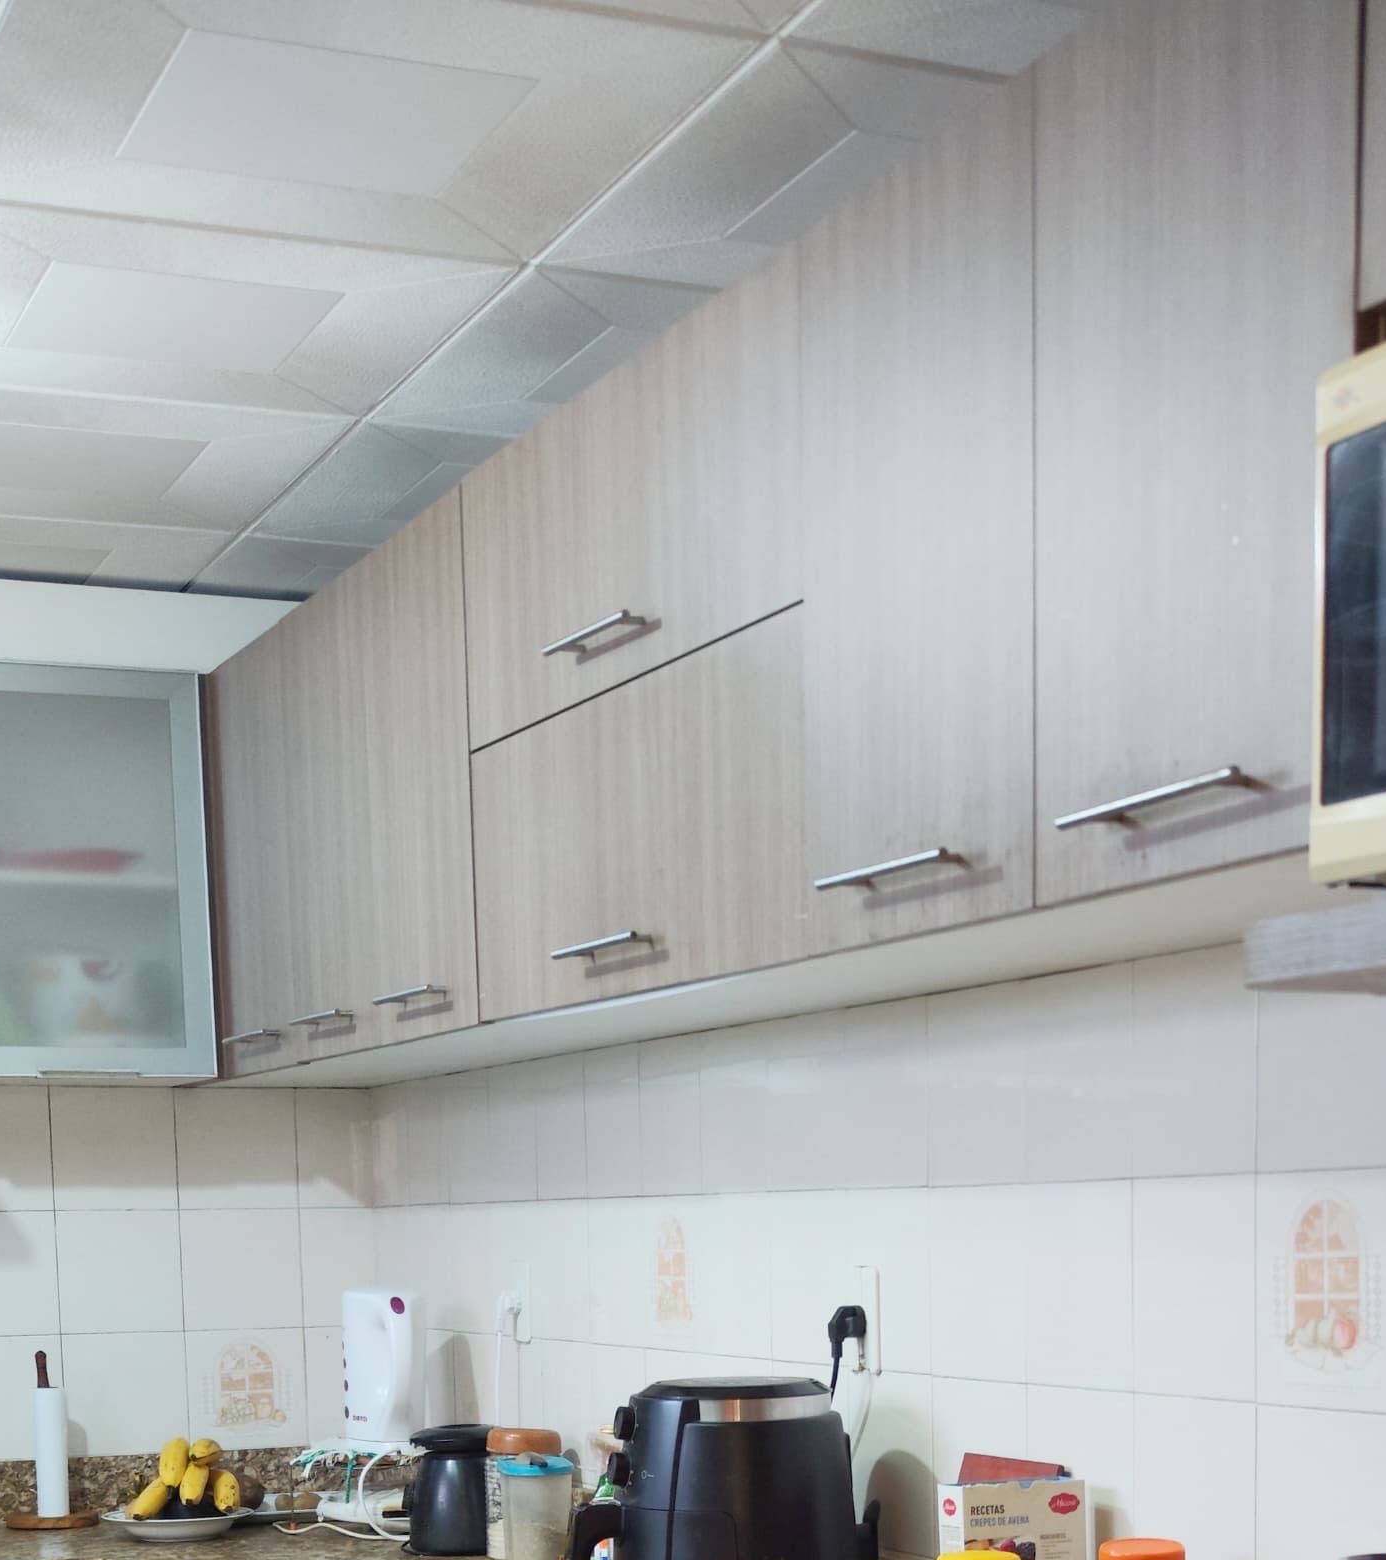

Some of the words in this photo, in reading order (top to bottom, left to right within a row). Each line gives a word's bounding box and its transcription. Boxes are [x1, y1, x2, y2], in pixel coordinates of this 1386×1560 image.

[970, 1504, 1005, 1516] RECETAS
[969, 1517, 996, 1527] CREPES
[997, 1516, 1005, 1526] DE
